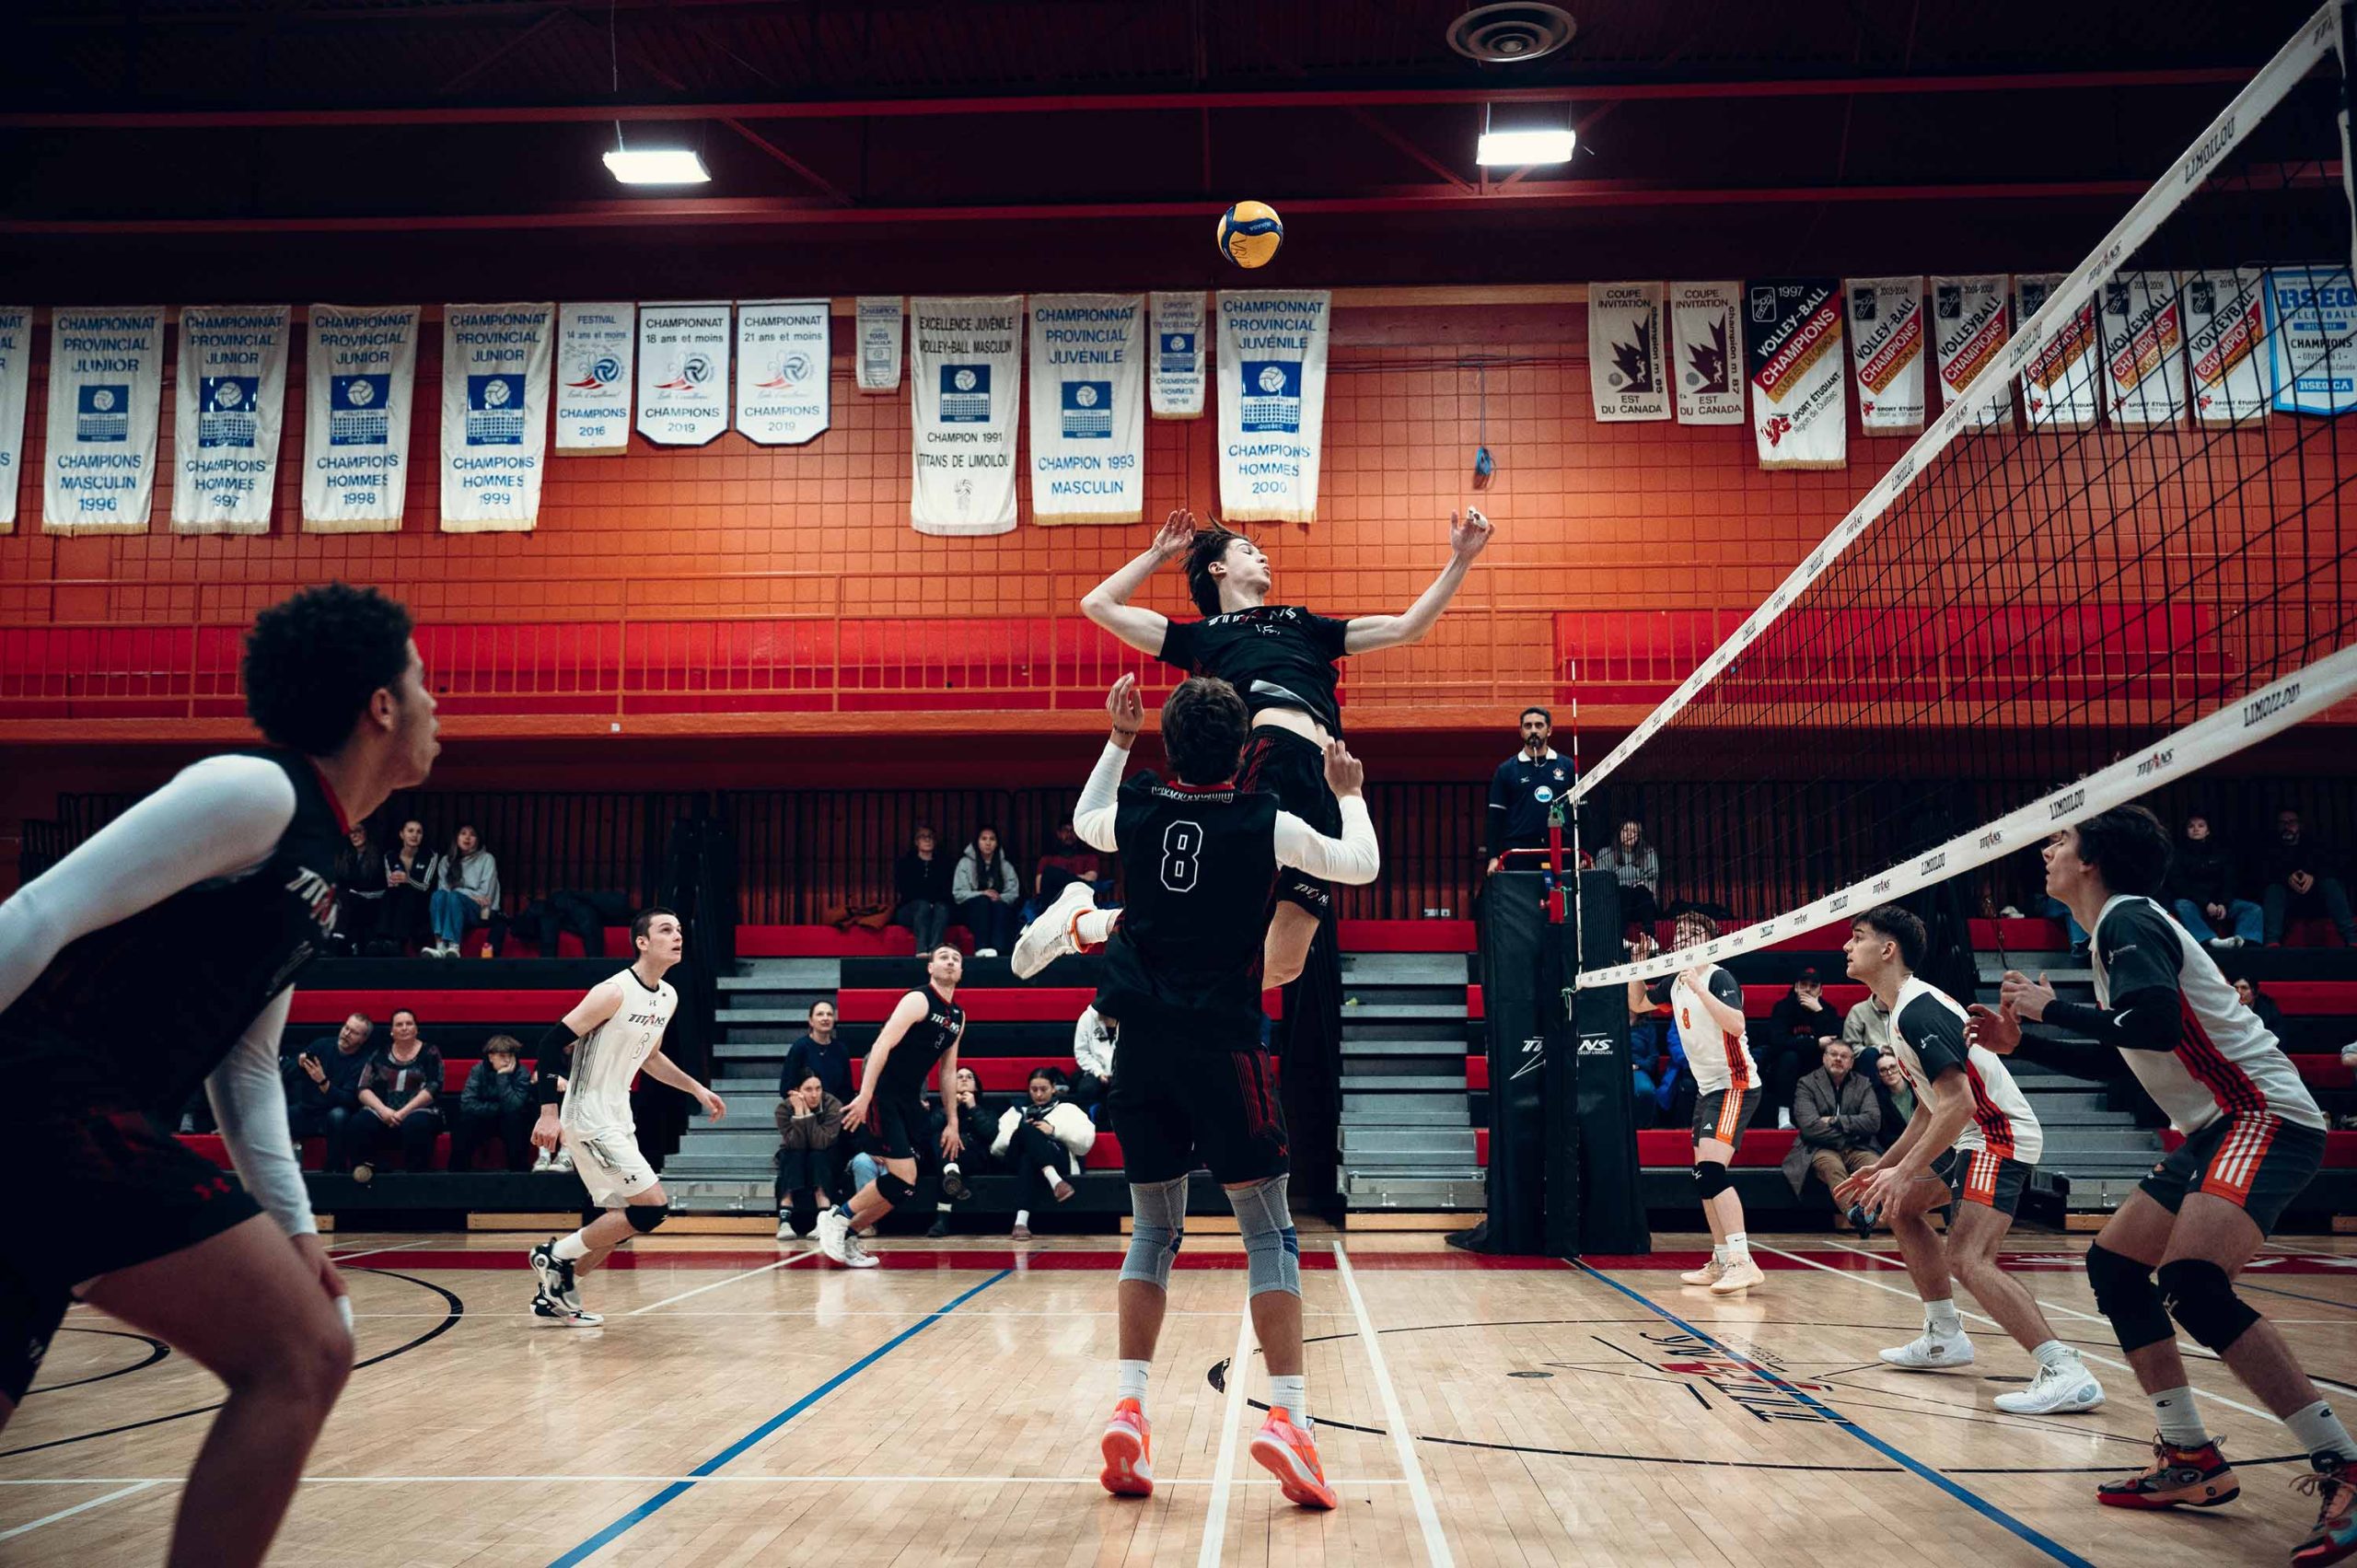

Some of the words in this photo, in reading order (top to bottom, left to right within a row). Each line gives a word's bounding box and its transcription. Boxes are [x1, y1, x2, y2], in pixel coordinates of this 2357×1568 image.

[2185, 117, 2235, 184] LIMOILOU
[1607, 289, 1642, 298] COUPE
[1685, 289, 1720, 298] COUPE
[1779, 286, 1804, 297] 1997
[2279, 287, 2357, 309] RSEQ
[1223, 300, 1324, 314] CHAMPIONNAT
[1598, 299, 1651, 308] INVITATION
[1676, 299, 1729, 308] INVITATION
[450, 313, 548, 327] CHAMPIONNAT
[578, 315, 617, 324] FESTIVAL
[744, 315, 821, 328] CHAMPIONNAT
[1036, 307, 1136, 322] CHAMPIONNAT
[58, 317, 155, 331] CHAMPIONNAT
[186, 317, 283, 329] CHAMPIONNAT
[315, 315, 413, 329] CHAMPIONNAT
[646, 318, 724, 330] CHAMPIONNAT
[921, 319, 970, 331] EXCELLENCE
[974, 316, 1013, 330] JUVÉNILE
[1230, 319, 1317, 331] PROVINCIAL
[1757, 285, 1829, 359] VOLLEY-BALL
[1938, 296, 2002, 359] VOLLEYBALL
[2107, 293, 2174, 355] VOLLEYBALL
[2191, 293, 2256, 354] VOLLEYBALL
[1046, 329, 1126, 343] PROVINCIAL
[1651, 306, 1659, 359] champion
[1855, 298, 1917, 361] VOLLEY-BALL
[192, 335, 275, 346] PROVINCIAL
[320, 333, 406, 346] PROVINCIAL
[456, 331, 540, 344] PROVINCIAL
[646, 334, 656, 344] 18
[661, 335, 677, 343] ans
[681, 333, 691, 343] et
[695, 333, 724, 343] moins
[744, 333, 755, 343] 21
[759, 334, 774, 343] ans
[780, 332, 790, 343] et
[794, 331, 822, 342] moins
[1238, 334, 1307, 349] JUVÉNILE
[2291, 339, 2352, 348] CHAMPIONS
[64, 338, 149, 351] PROVINCIAL
[920, 341, 970, 354] VOLLEY-BALL
[974, 341, 1012, 354] MASCULIN
[1761, 308, 1836, 387] CHAMPIONS
[1945, 320, 2003, 381] CHAMPIONS
[2009, 321, 2042, 368] LIMOILOU
[2030, 319, 2085, 377] CHAMPIONS
[2113, 318, 2173, 377] CHAMPIONS
[2199, 315, 2256, 376] CHAMPIONS
[206, 353, 259, 364] JUNIOR
[336, 352, 389, 365] JUNIOR
[471, 350, 525, 362] JUNIOR
[1049, 346, 1123, 365] JUVÉNILE
[1862, 322, 1920, 383] CHAMPIONS
[72, 359, 139, 372] JUNIOR
[1870, 347, 1915, 391] DIVISION
[1732, 379, 1740, 394] 87
[2300, 381, 2350, 390] RSEQCA
[1621, 395, 1640, 403] EST
[1700, 396, 1718, 405] EST
[1792, 401, 1812, 422] SPORT
[1810, 372, 1841, 403] ÉTUDIANT
[560, 408, 626, 419] CHAMPIONS
[645, 408, 720, 418] CHAMPIONS
[744, 406, 819, 416] CHAMPIONS
[1601, 405, 1617, 414] DU
[1620, 405, 1663, 413] CANADA
[1679, 407, 1695, 416] DU
[1698, 405, 1742, 414] CANADA
[579, 425, 606, 436] 2016
[668, 422, 696, 433] 2019
[768, 422, 795, 431] 2019
[927, 433, 978, 443] CHAMPION
[982, 432, 1003, 442] 1991
[1228, 444, 1310, 458] CHAMPIONS
[58, 455, 141, 469] CHAMPIONS
[186, 459, 265, 471] CHAMPIONS
[317, 454, 399, 470] CHAMPIONS
[453, 456, 534, 470] CHAMPIONS
[920, 455, 948, 468] TITANS
[953, 455, 963, 468] DE
[969, 454, 1009, 468] LIMOILOU
[1039, 457, 1101, 471] CHAMPION
[1108, 455, 1134, 470] 1993
[1238, 463, 1300, 477] HOMMES
[61, 477, 136, 490] MASCULIN
[195, 478, 254, 490] HOMMES
[327, 473, 389, 488] HOMMES
[463, 475, 524, 488] HOMMES
[1051, 481, 1123, 495] MASCULIN
[1252, 482, 1287, 494] 2000
[78, 498, 116, 511] 1996
[212, 495, 239, 508] 997
[343, 493, 376, 505] 1998
[479, 494, 510, 505] 1999
[2244, 683, 2300, 727] LIMOILOU
[2136, 749, 2174, 777] TITANS
[2049, 788, 2084, 820] LIMOILOU
[1980, 830, 2003, 849] TITANS
[1161, 820, 1202, 892] 8
[1922, 853, 1945, 876] LIMOILOU
[1294, 883, 1329, 903] TITAN
[1873, 878, 1890, 895] TITANS
[285, 865, 338, 932] TITAN
[628, 1013, 666, 1026] TITANS
